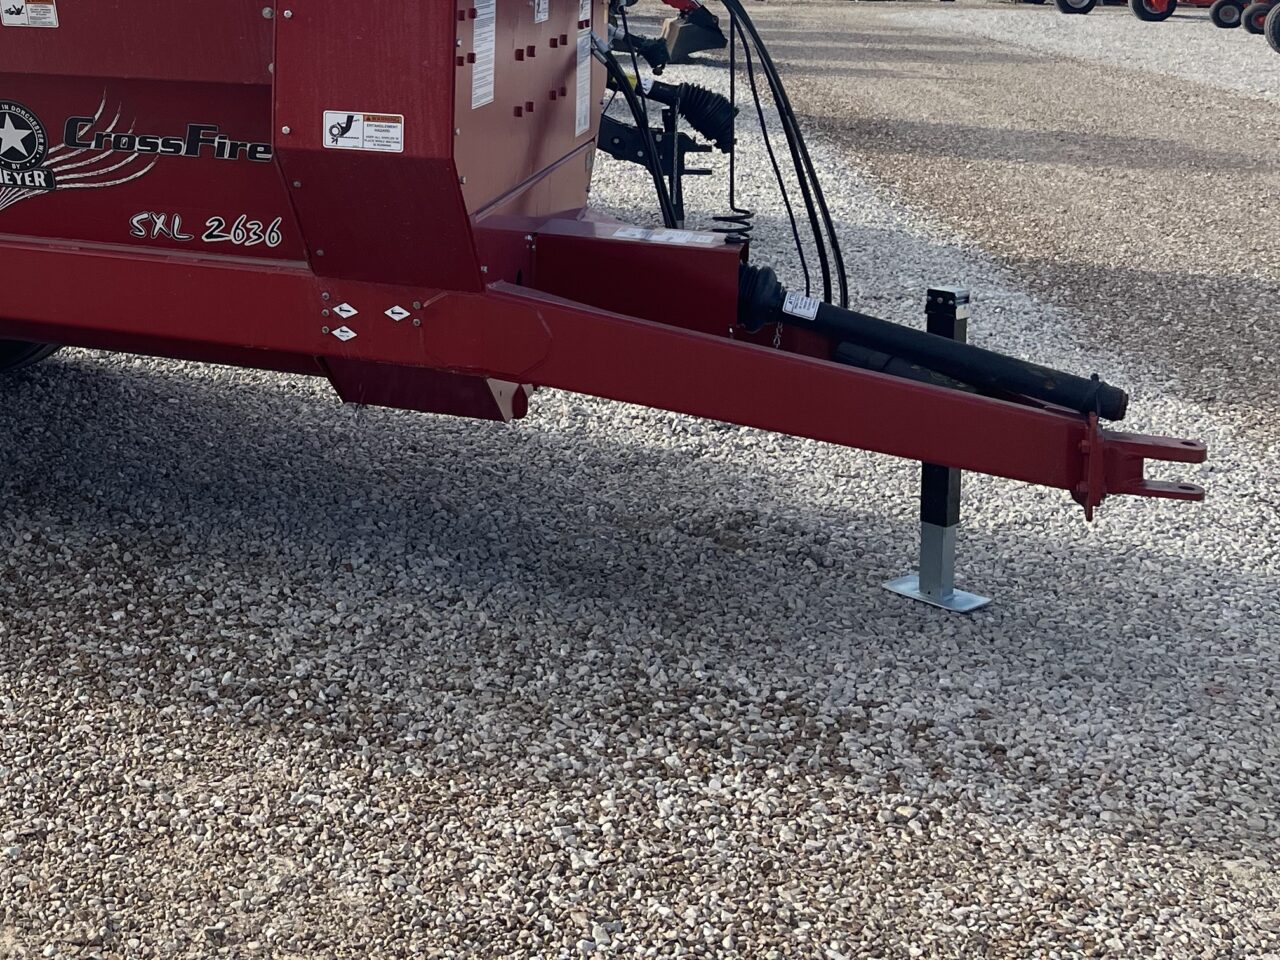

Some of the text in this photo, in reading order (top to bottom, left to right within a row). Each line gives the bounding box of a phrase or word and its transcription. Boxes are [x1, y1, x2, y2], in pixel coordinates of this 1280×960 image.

[1, 103, 9, 111] IN
[10, 105, 44, 143] DORCHESTER
[63, 116, 273, 163] CrossFire
[129, 211, 283, 248] SXL 2636
